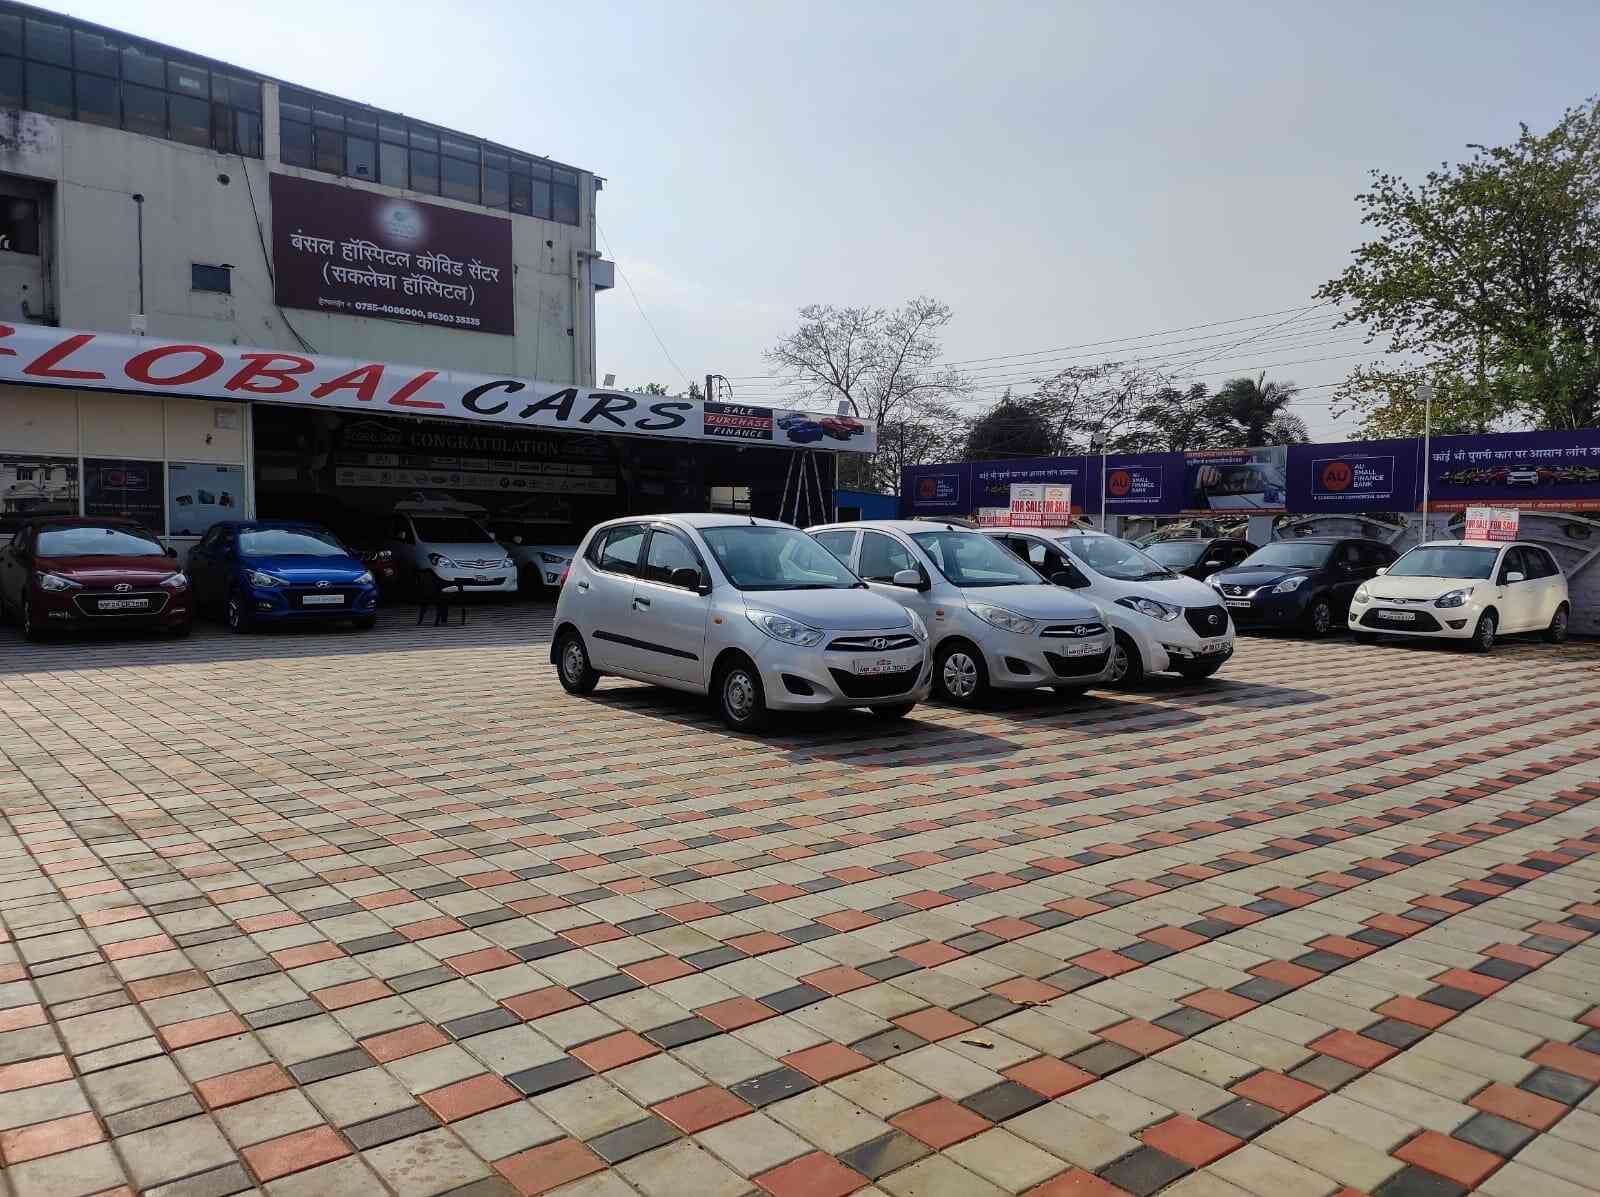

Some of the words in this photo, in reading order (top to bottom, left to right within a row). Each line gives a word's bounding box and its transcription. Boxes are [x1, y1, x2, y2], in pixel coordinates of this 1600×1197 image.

[290, 229, 334, 256] बंसल
[341, 237, 410, 269] हॉस्पिटल
[416, 251, 463, 278] कोविड
[467, 258, 500, 283] सेंटर
[322, 262, 396, 290] (सकलेचा
[403, 273, 475, 306] हॉस्पिटल)
[461, 379, 694, 431] CARS
[723, 406, 754, 416] SALE
[707, 415, 769, 428] PURCHASE
[713, 426, 762, 438] FINANCE
[1012, 500, 1025, 512] FOR
[1026, 500, 1041, 512] SALE
[1043, 500, 1054, 512] FOR
[1055, 500, 1068, 512] SALE
